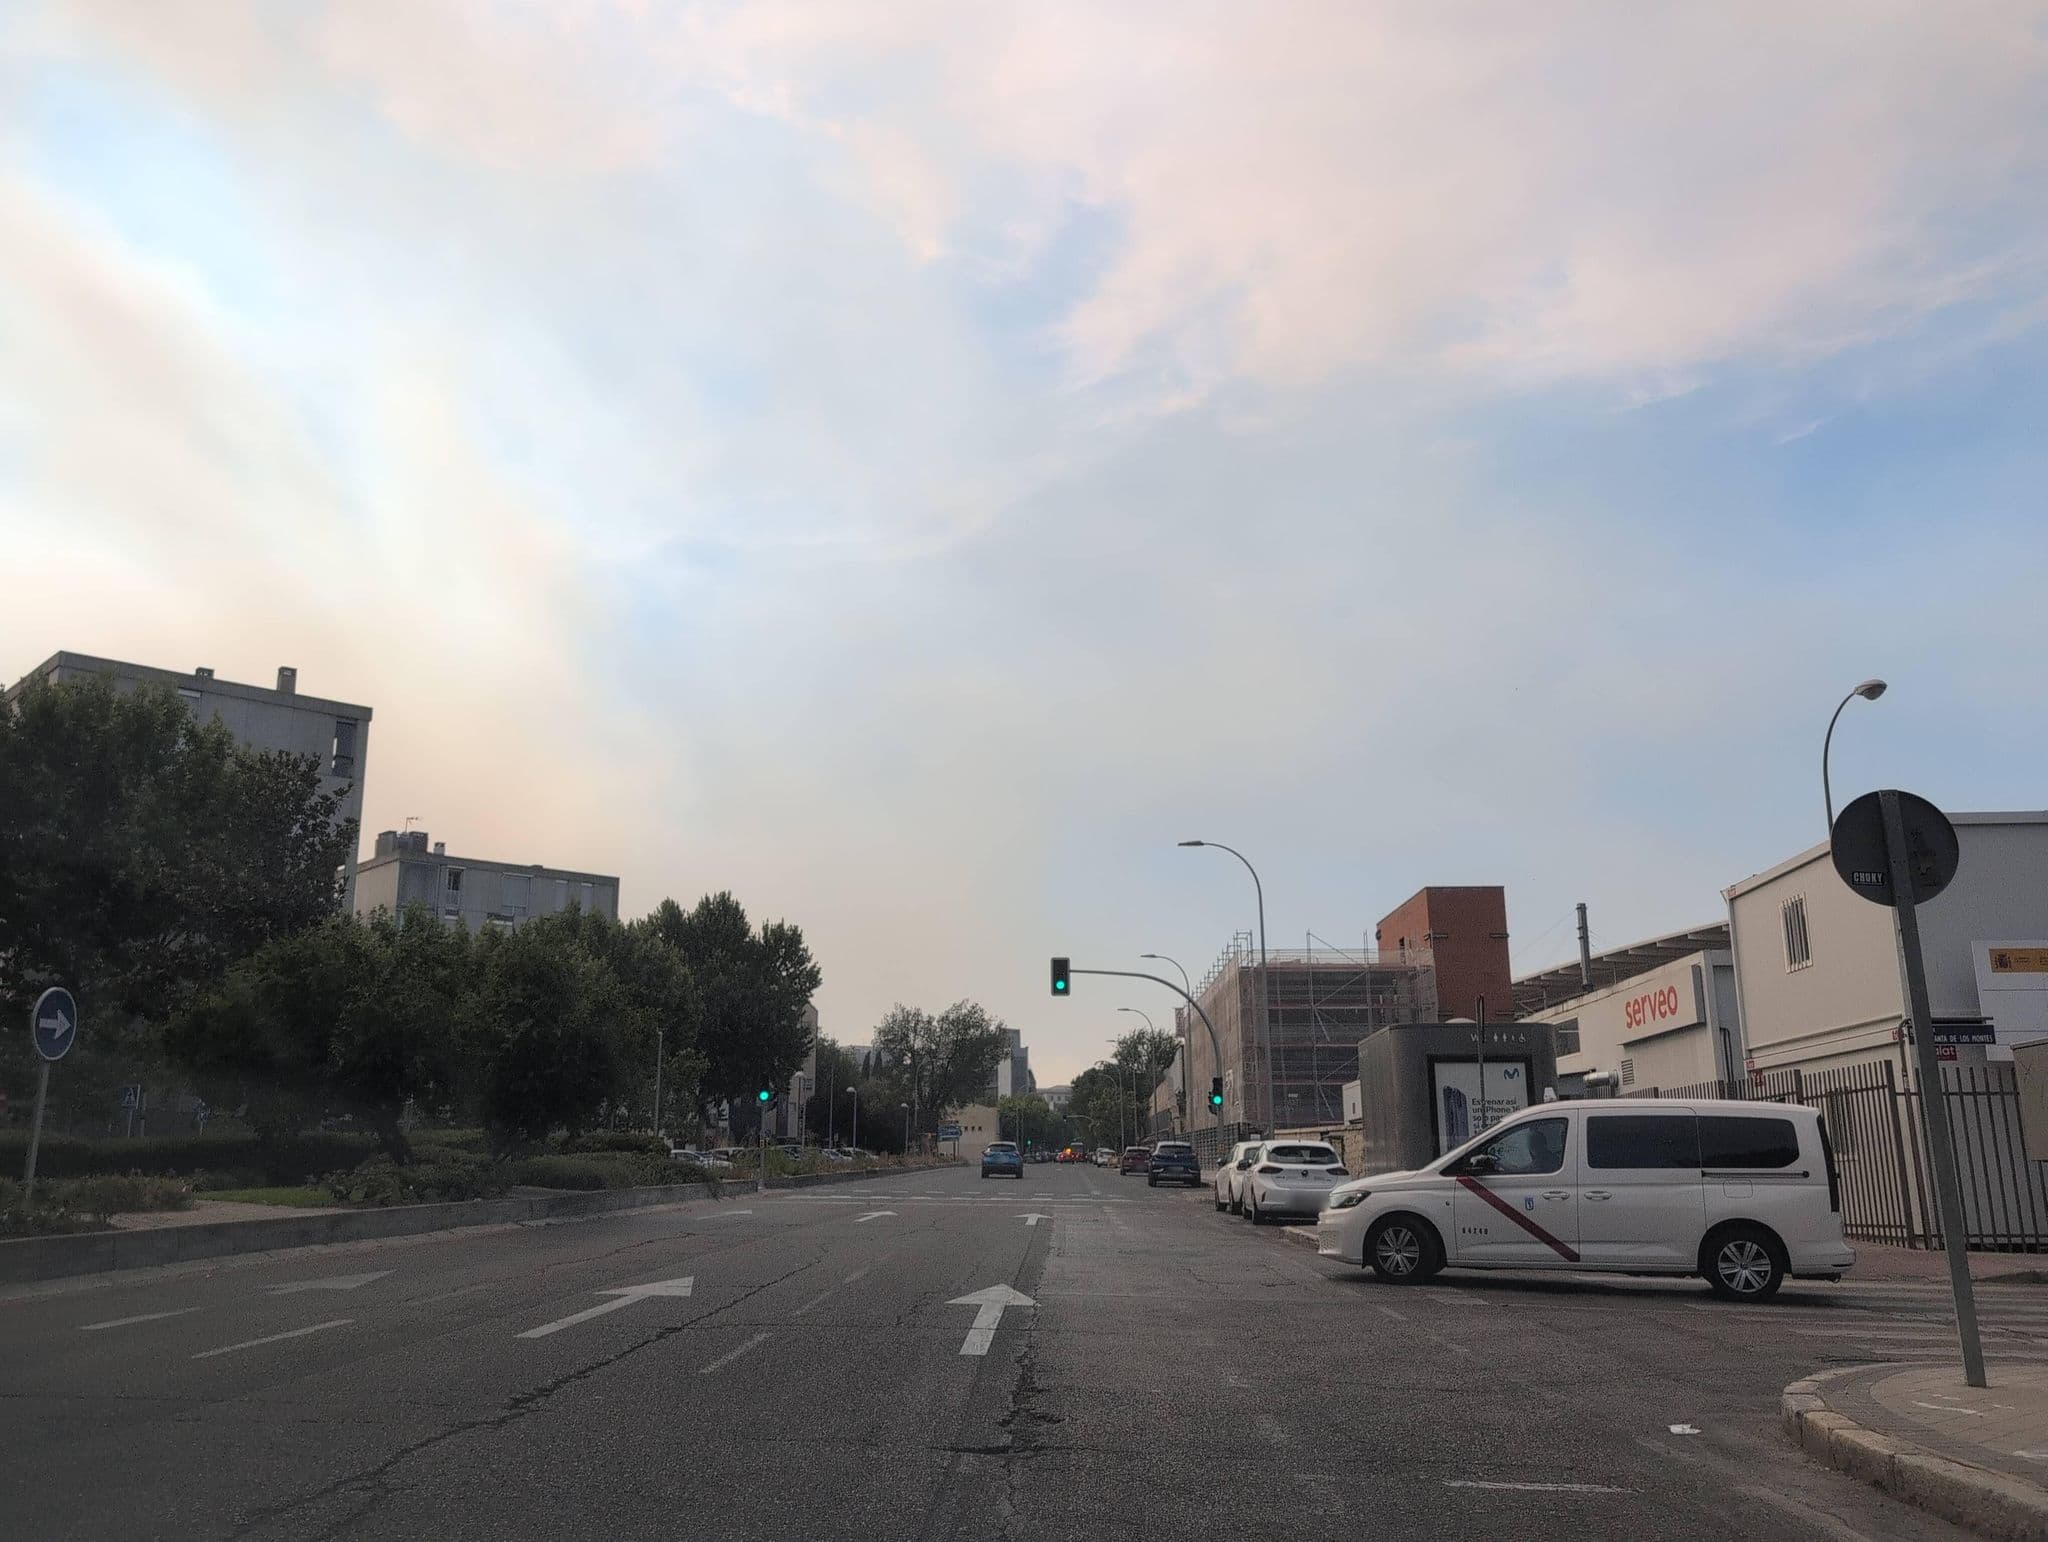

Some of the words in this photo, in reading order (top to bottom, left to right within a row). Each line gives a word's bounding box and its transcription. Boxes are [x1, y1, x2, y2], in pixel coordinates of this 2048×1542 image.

[1625, 985, 1678, 1029] serveo
[1934, 1034, 1948, 1043] ANTA
[1949, 1034, 1957, 1043] DE
[1960, 1034, 1970, 1043] LOS
[1972, 1034, 1993, 1043] MONTES
